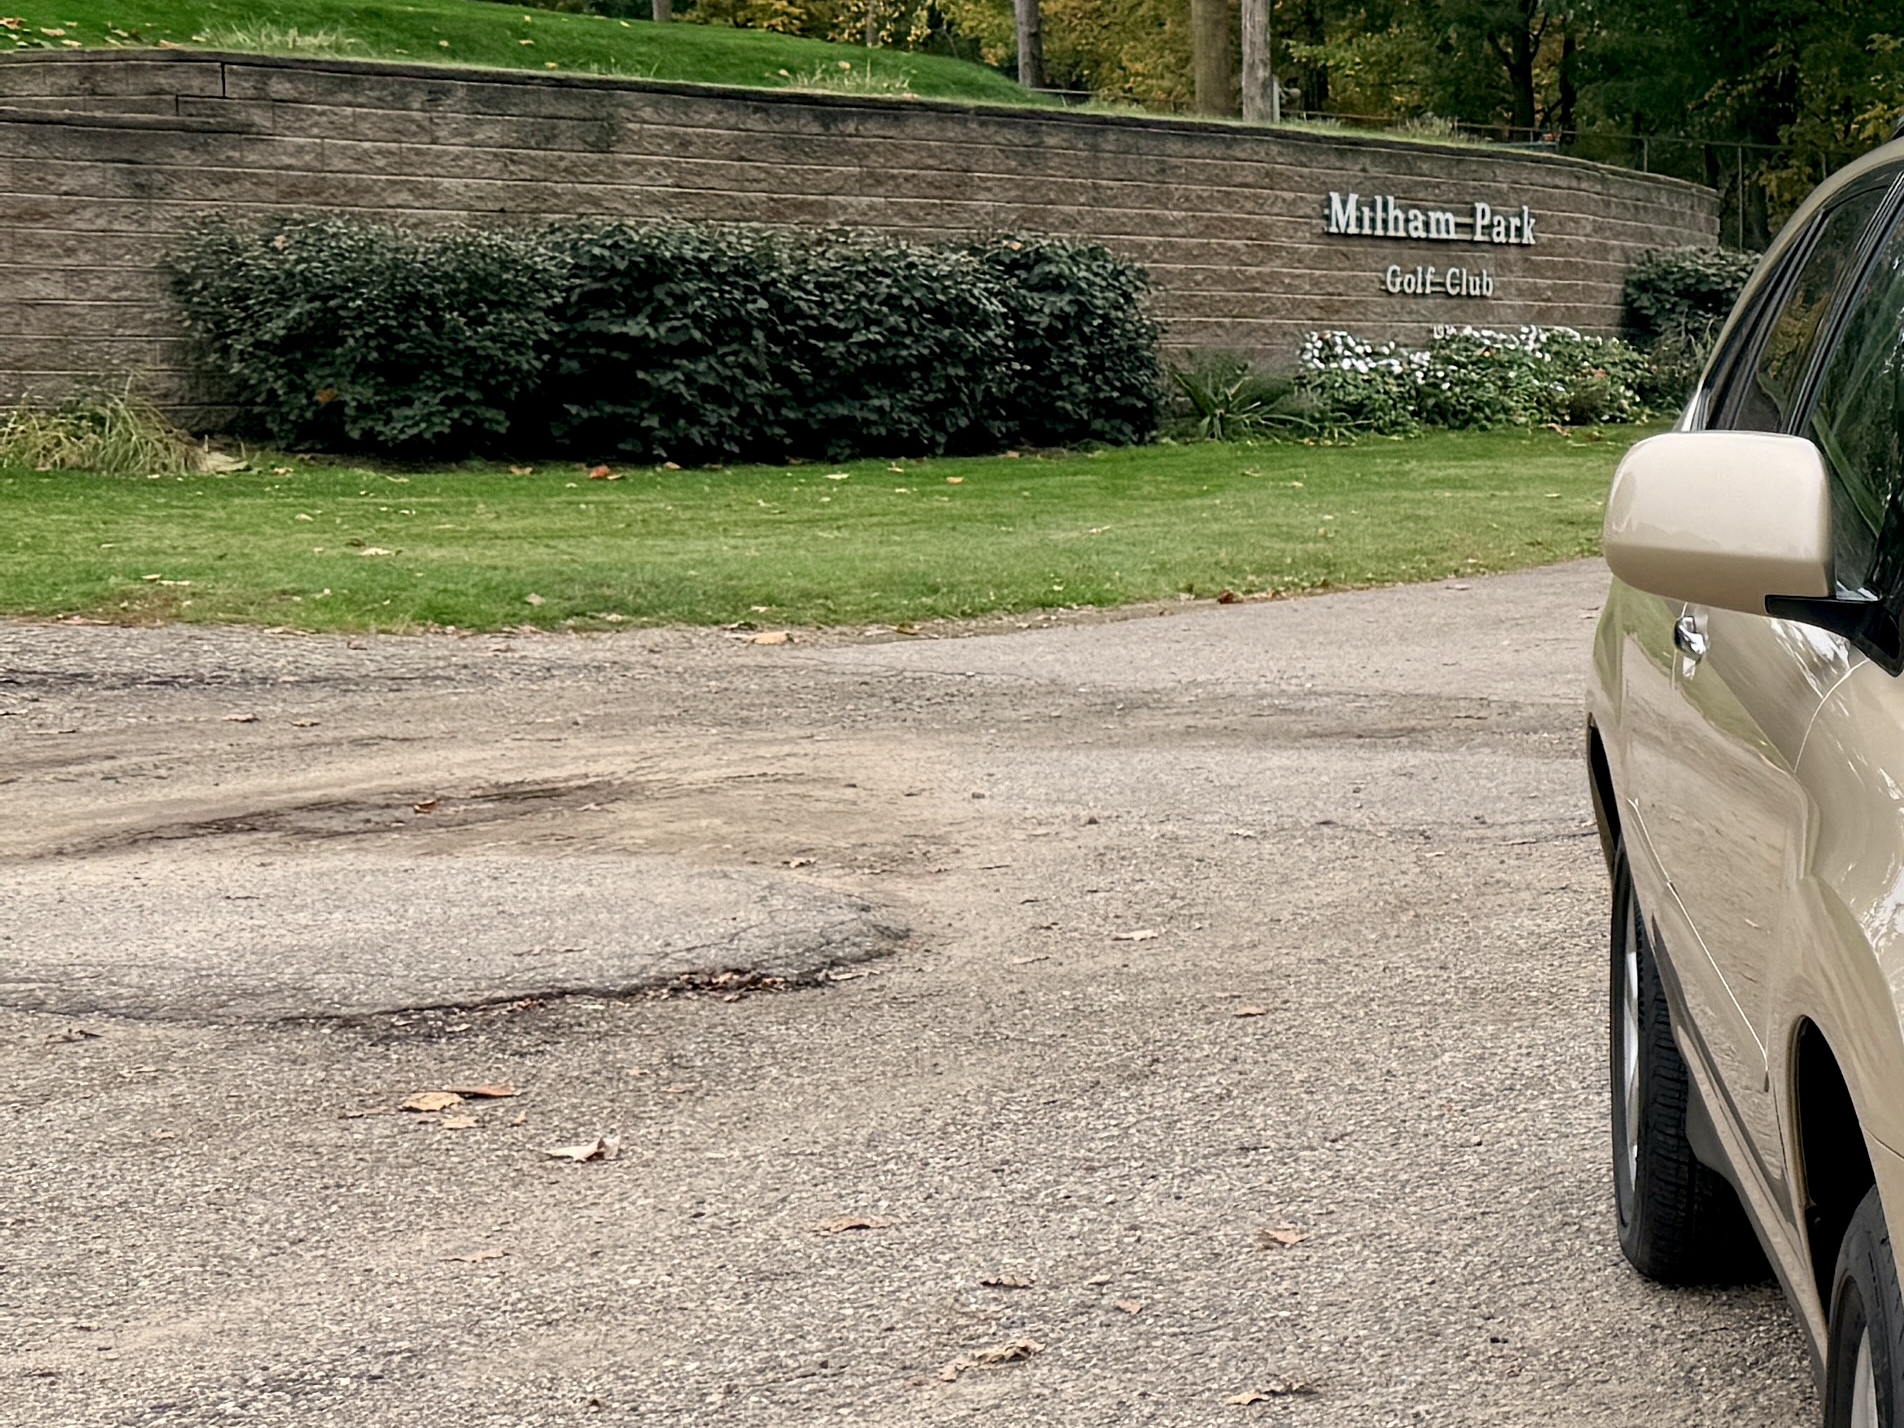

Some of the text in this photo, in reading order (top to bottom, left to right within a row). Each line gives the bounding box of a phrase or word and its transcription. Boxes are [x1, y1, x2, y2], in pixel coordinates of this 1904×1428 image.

[1328, 191, 1536, 245] Milham Park
[1386, 264, 1494, 297] Golf Club
